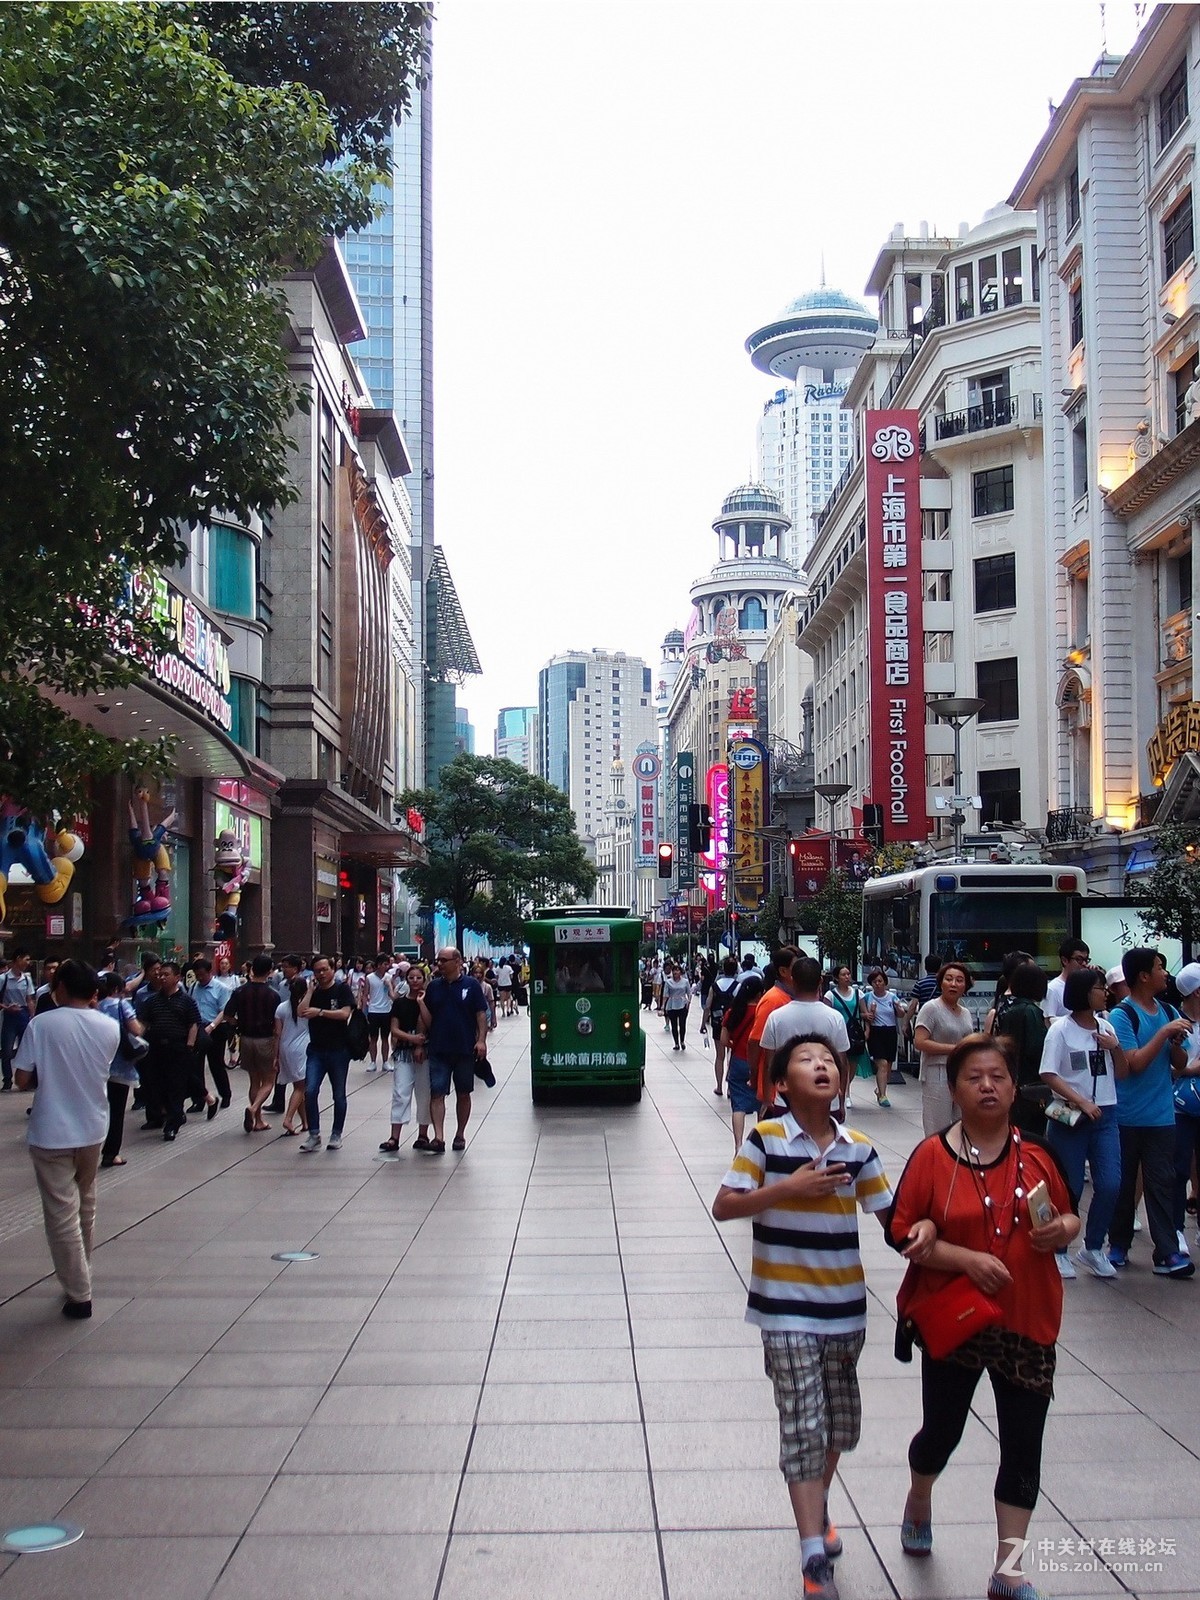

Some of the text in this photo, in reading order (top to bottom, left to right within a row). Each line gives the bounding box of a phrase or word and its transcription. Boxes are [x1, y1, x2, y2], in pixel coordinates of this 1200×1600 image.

[881, 473, 909, 686] 上海市第一食品商店
[889, 699, 909, 823] First Foodhall
[572, 928, 605, 936] 观光车
[536, 982, 541, 992] 5
[540, 1052, 628, 1066] 专业除菌用滴露
